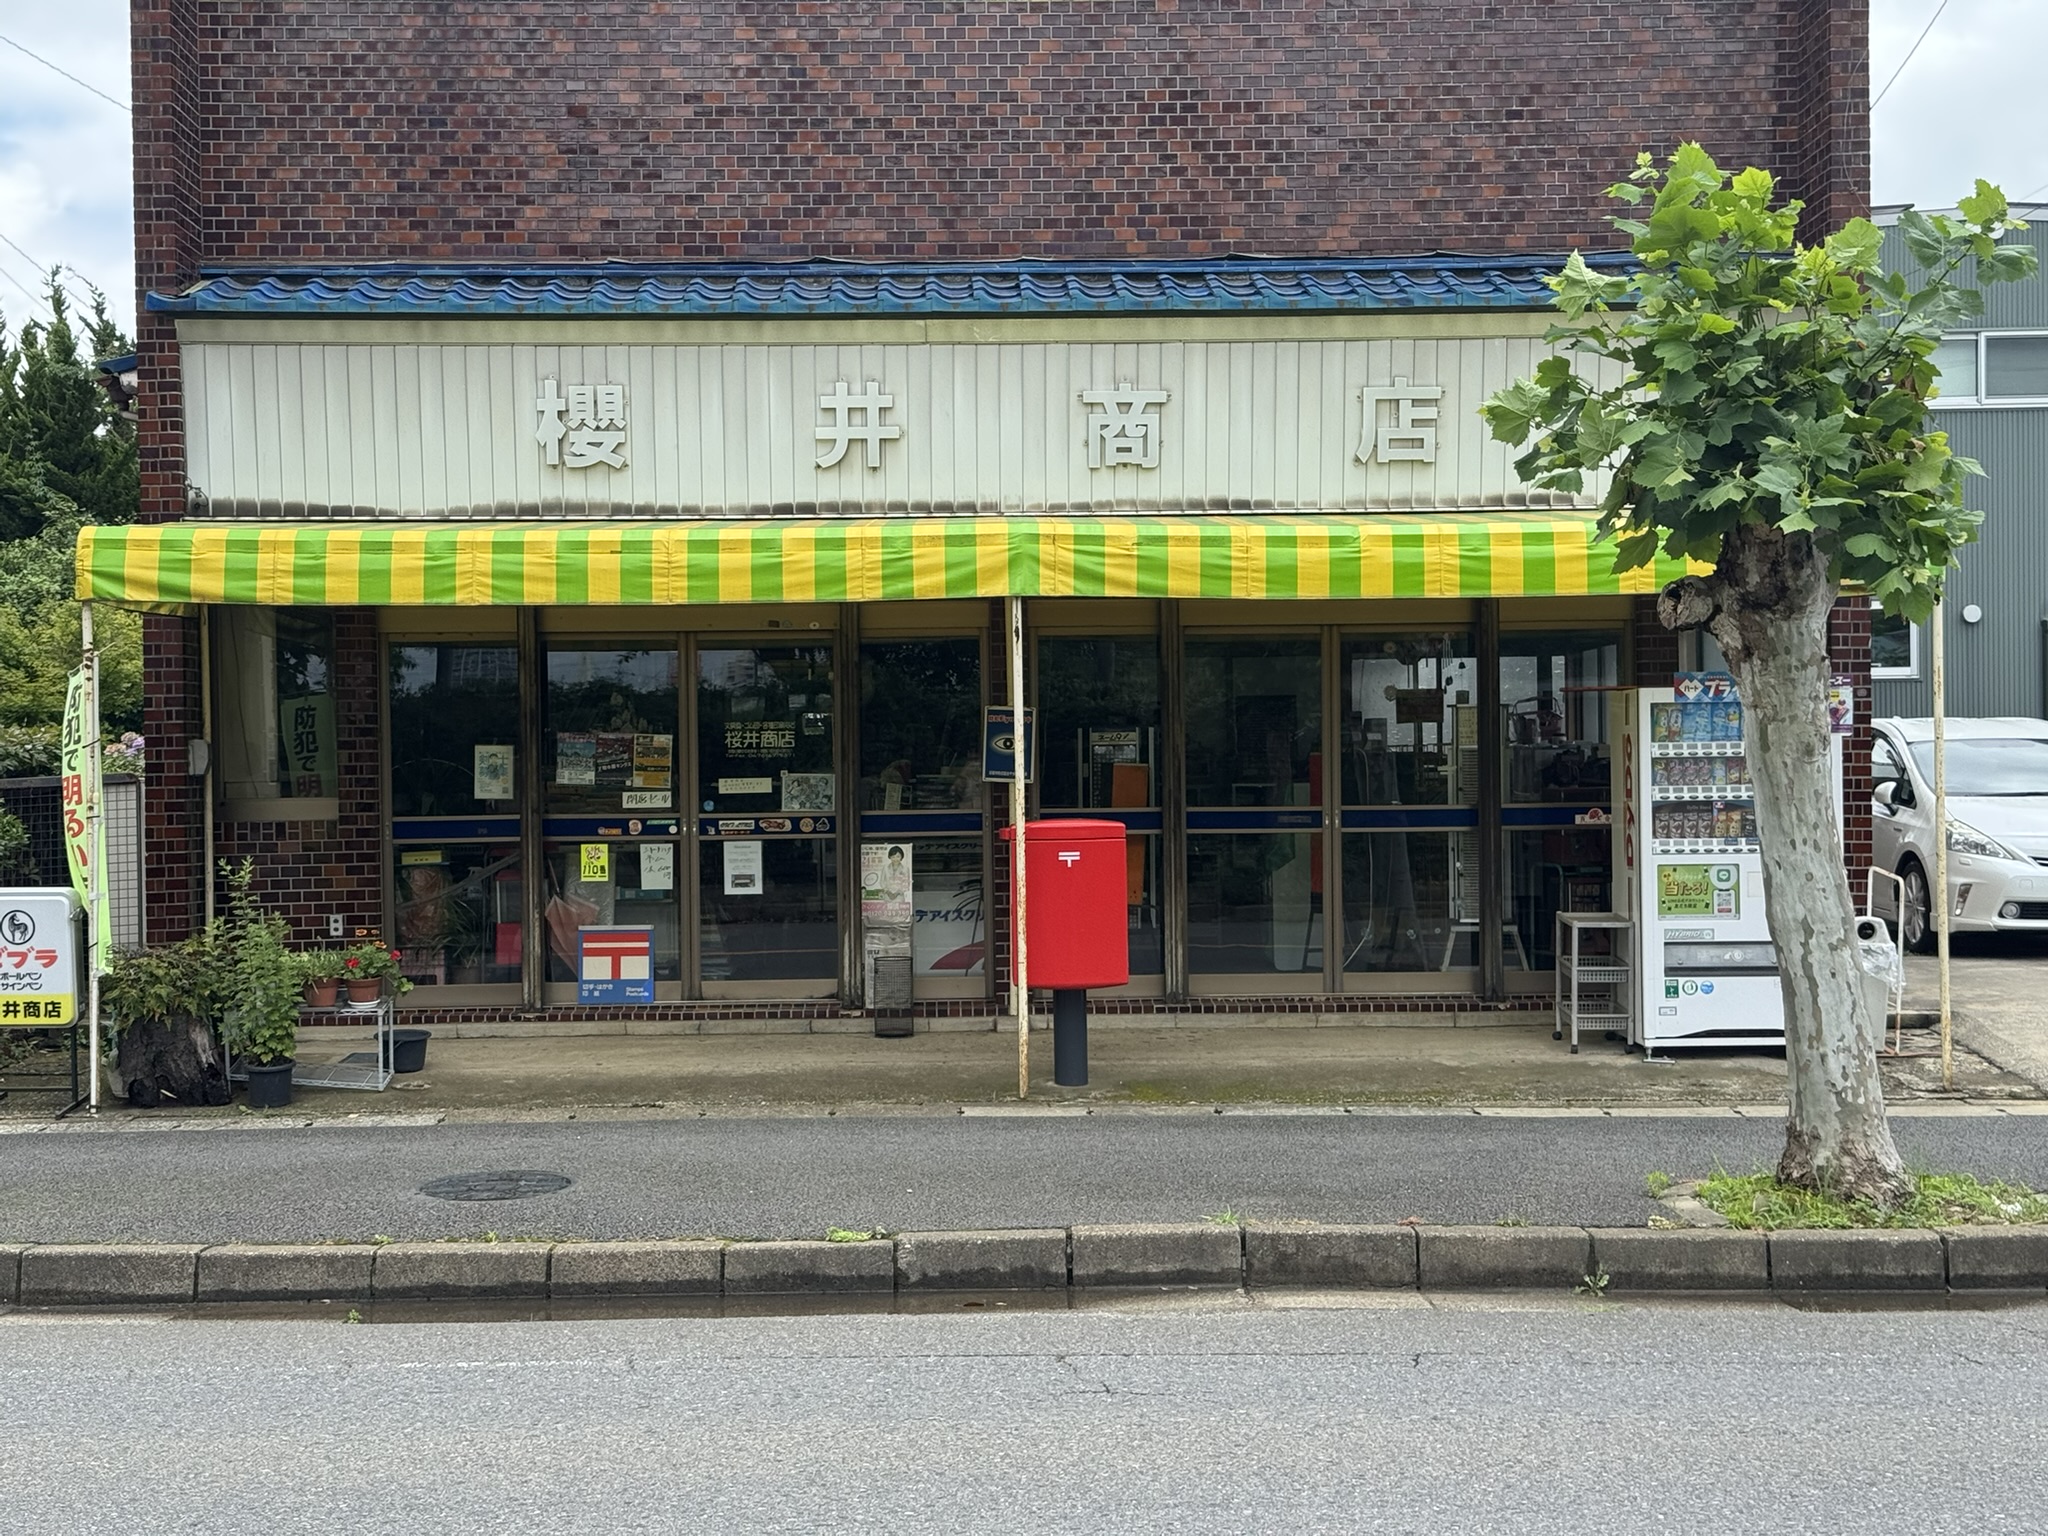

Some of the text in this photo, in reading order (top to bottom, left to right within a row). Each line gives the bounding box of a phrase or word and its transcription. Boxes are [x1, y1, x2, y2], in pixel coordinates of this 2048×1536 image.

[536, 374, 1446, 472] 櫻井商店
[1684, 684, 1699, 692] ハート
[724, 730, 796, 748] 桜井商店
[1666, 930, 1700, 940] HYBRID
[0, 972, 42, 981] ボールペン
[1, 982, 43, 991] サインペン
[2, 1000, 62, 1019] 井商店
